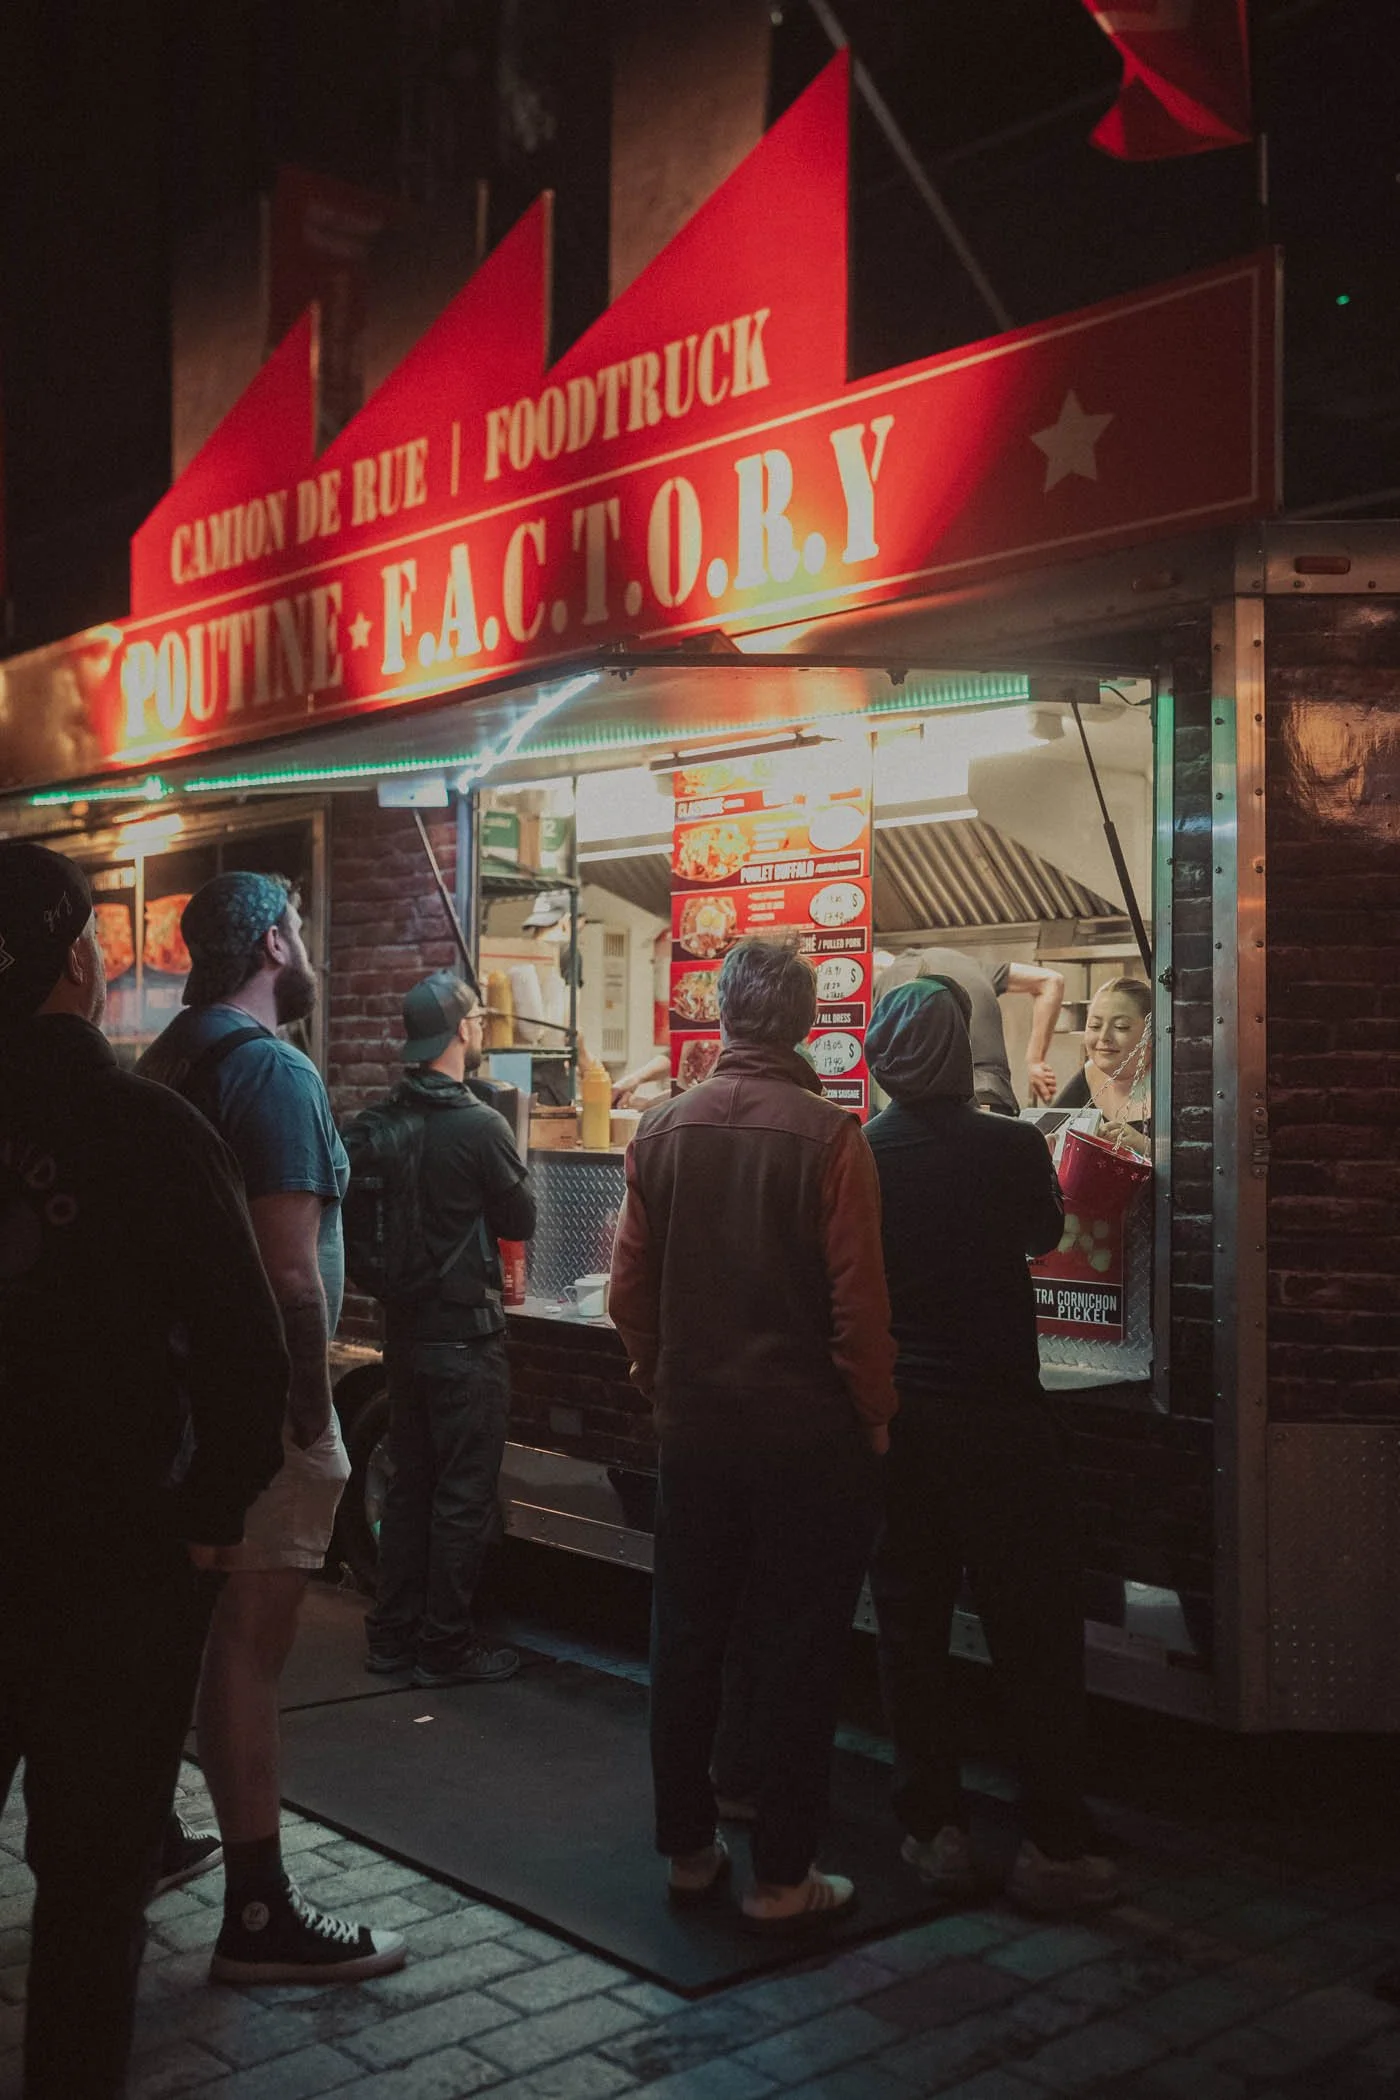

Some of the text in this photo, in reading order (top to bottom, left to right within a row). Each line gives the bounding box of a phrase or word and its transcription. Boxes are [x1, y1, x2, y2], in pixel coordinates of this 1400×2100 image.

[171, 498, 286, 584] CAMION
[297, 470, 342, 544] DE
[351, 437, 430, 528] RUE
[484, 307, 774, 483] FOODTRUCK
[120, 582, 343, 742] POUTINE
[820, 1013, 832, 1024] ALL
[1035, 1288, 1117, 1311] TRA CORNICHON
[1058, 1306, 1108, 1324] PICKEL
